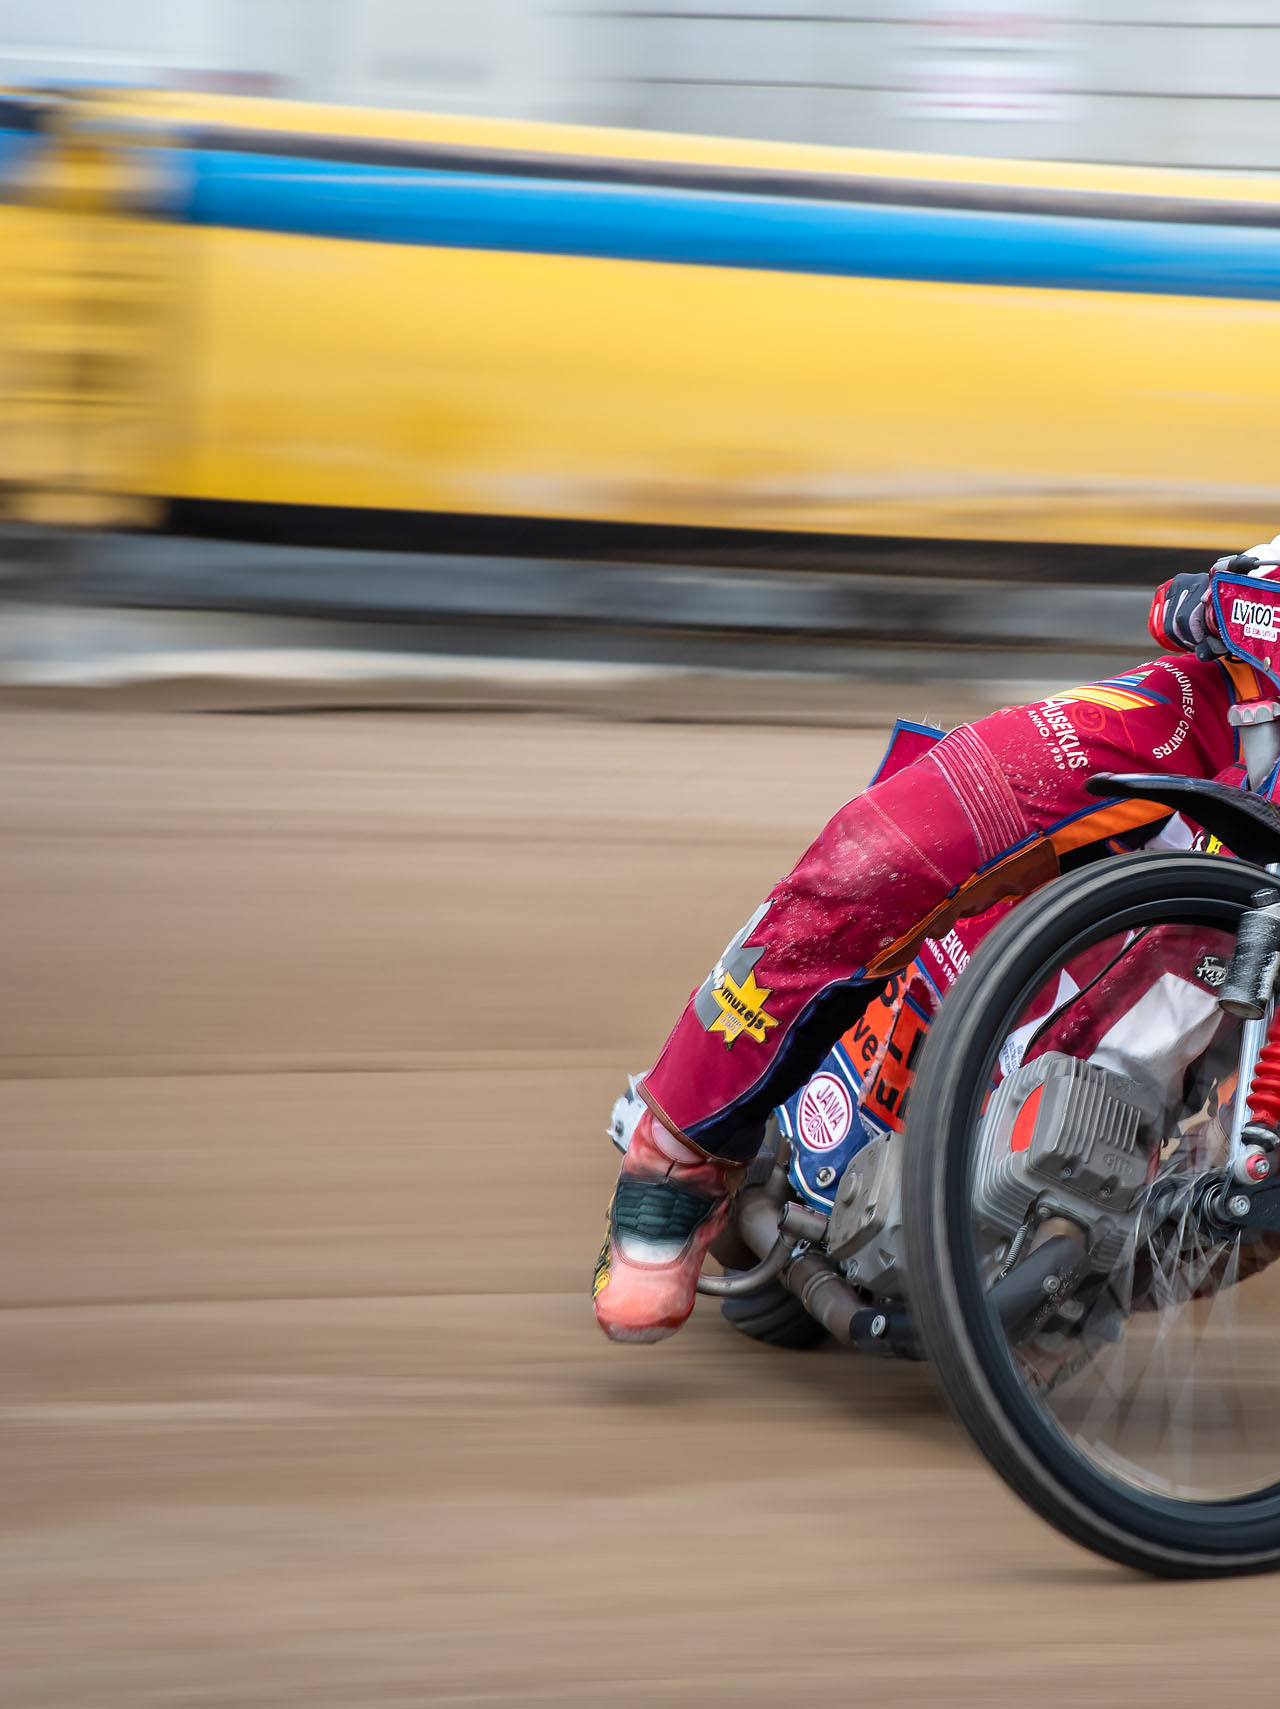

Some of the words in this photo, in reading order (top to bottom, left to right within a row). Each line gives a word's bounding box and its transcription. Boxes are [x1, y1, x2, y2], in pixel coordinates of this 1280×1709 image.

[1026, 710, 1050, 739] ANNO
[1047, 741, 1066, 771] 1989
[1033, 698, 1089, 770] AUSEKLIS
[1152, 719, 1190, 759] CENTRS
[940, 929, 971, 975] EKLIS
[721, 987, 766, 1029] muzejs
[816, 1084, 842, 1132] JAWA
